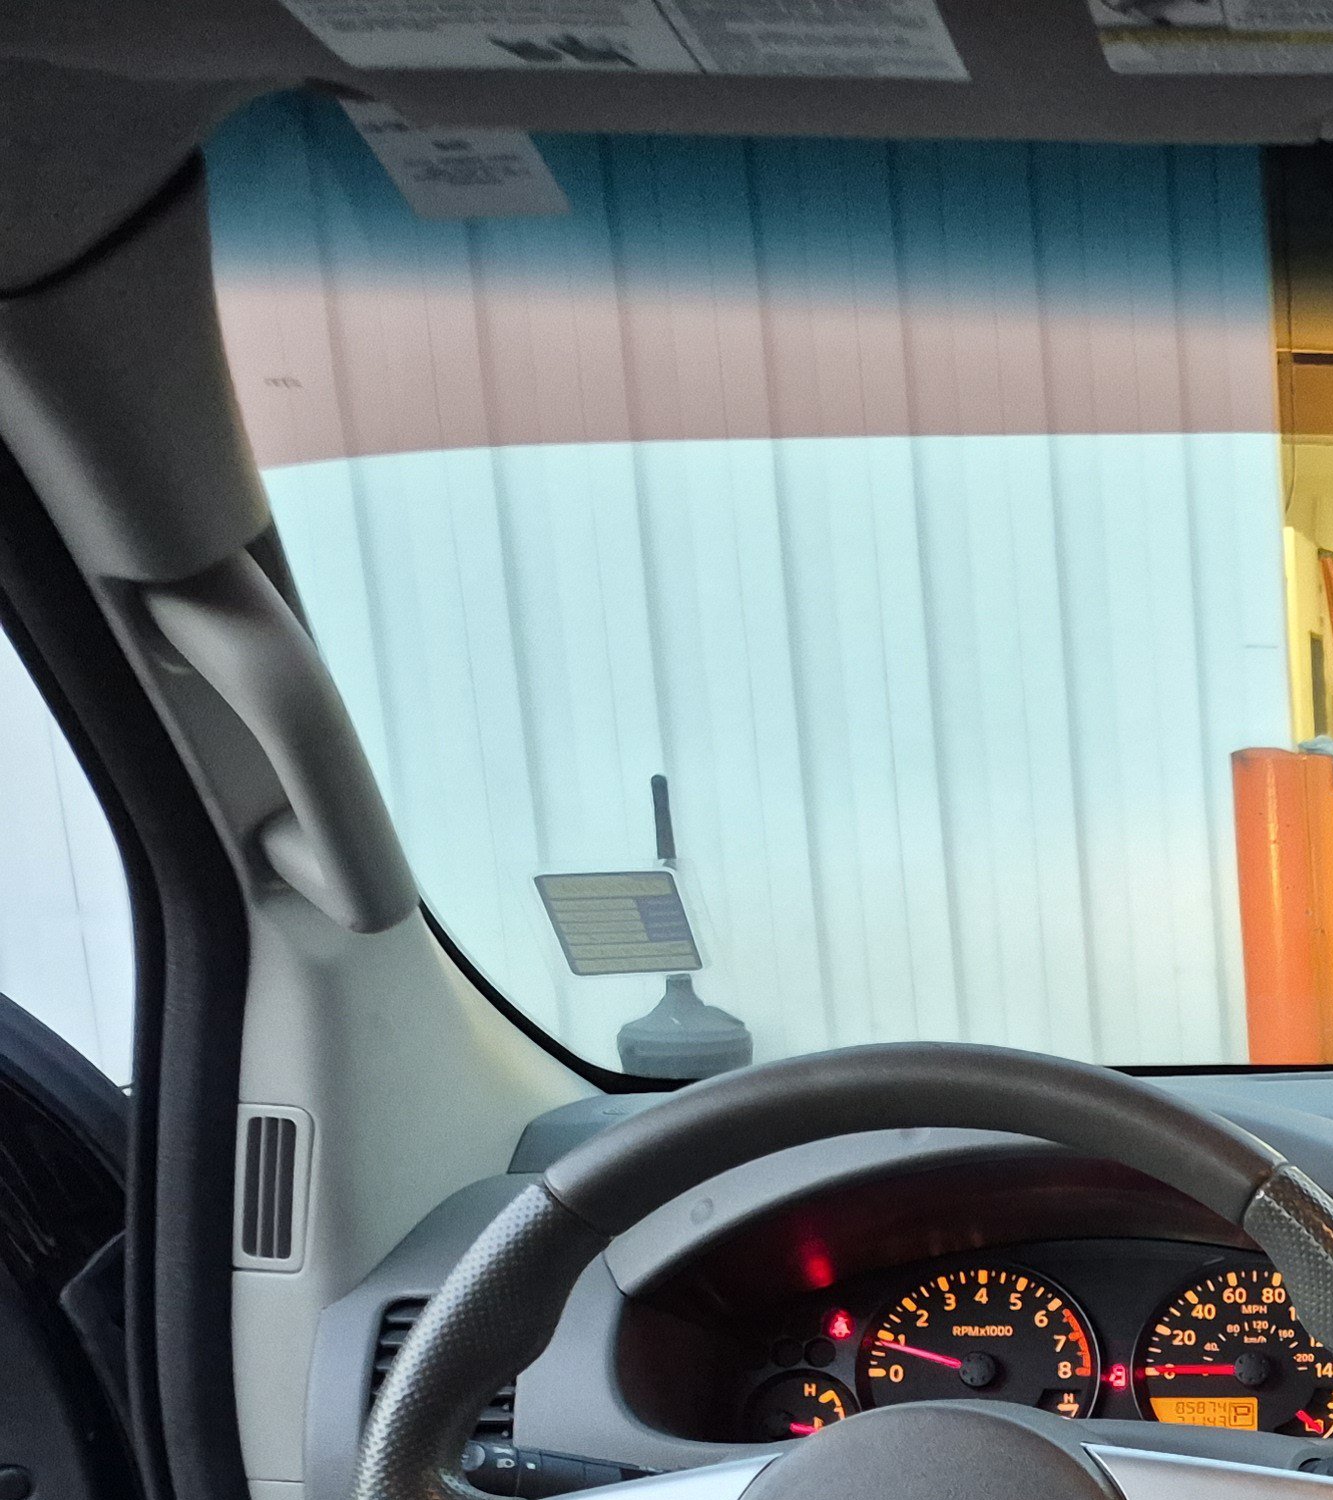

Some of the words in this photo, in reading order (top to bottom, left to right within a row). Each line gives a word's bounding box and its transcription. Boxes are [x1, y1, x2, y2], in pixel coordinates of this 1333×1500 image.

[943, 1293, 957, 1311] 3
[974, 1287, 989, 1305] 4
[1009, 1293, 1022, 1311] 5
[1222, 1287, 1247, 1304] 60
[1261, 1287, 1286, 1304] 80
[916, 1309, 929, 1327] 2
[1034, 1310, 1048, 1327] 6
[1191, 1303, 1216, 1320] 40
[1241, 1305, 1267, 1315] MPH
[1253, 1321, 1269, 1331] 120
[1053, 1335, 1067, 1352] 7
[1172, 1330, 1196, 1346] 20
[889, 1364, 904, 1382] 0
[1058, 1361, 1072, 1379] 8
[804, 1383, 816, 1397] H
[1063, 1393, 1074, 1403] H
[1175, 1402, 1227, 1415] 85874
[1234, 1405, 1251, 1423] P
